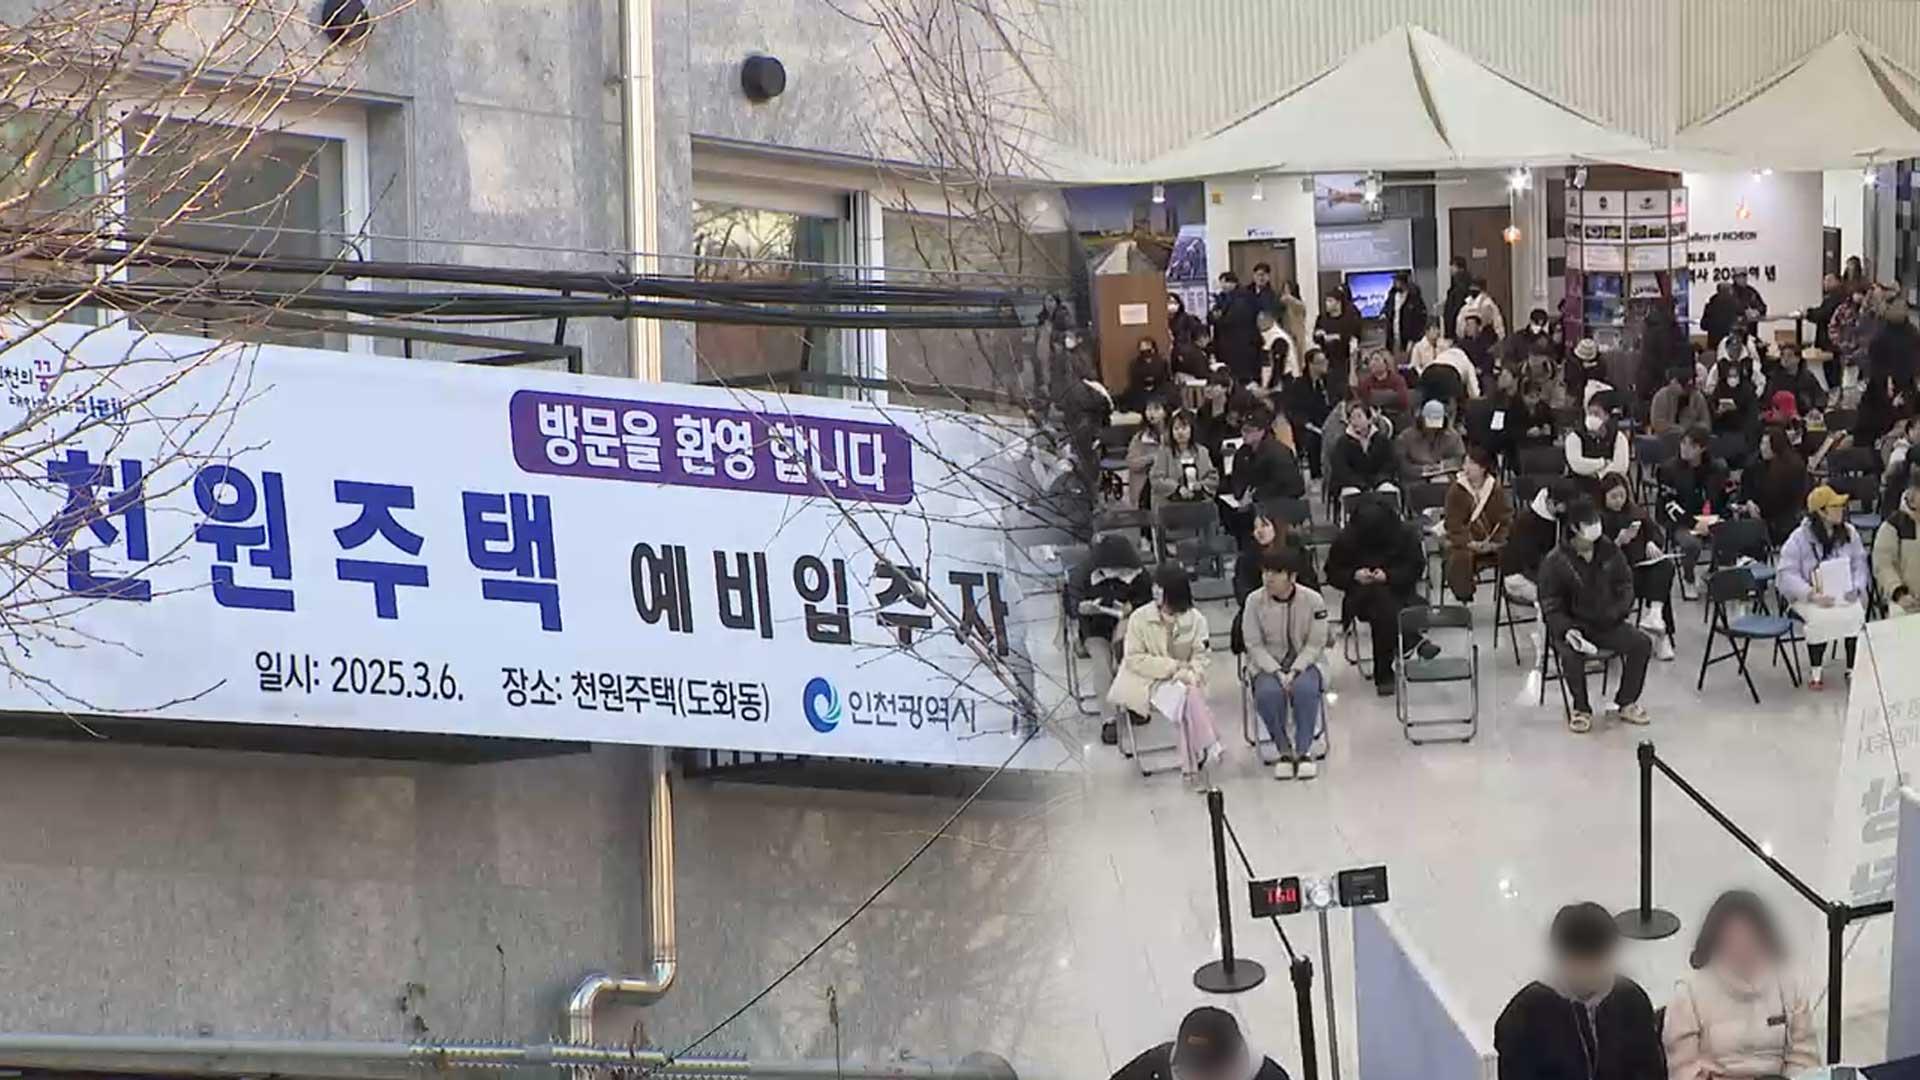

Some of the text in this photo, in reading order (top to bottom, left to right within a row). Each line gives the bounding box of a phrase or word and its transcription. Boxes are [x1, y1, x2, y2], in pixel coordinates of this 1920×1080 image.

[33, 359, 59, 392] 꿈
[538, 402, 887, 492] 방문을 환영 합니다
[47, 449, 1009, 657] 천원주택 예비입주자
[255, 651, 770, 723] 일시: 2025.3.6. 장소: 천원주택(도화동)
[849, 690, 976, 733] 인천광역시
